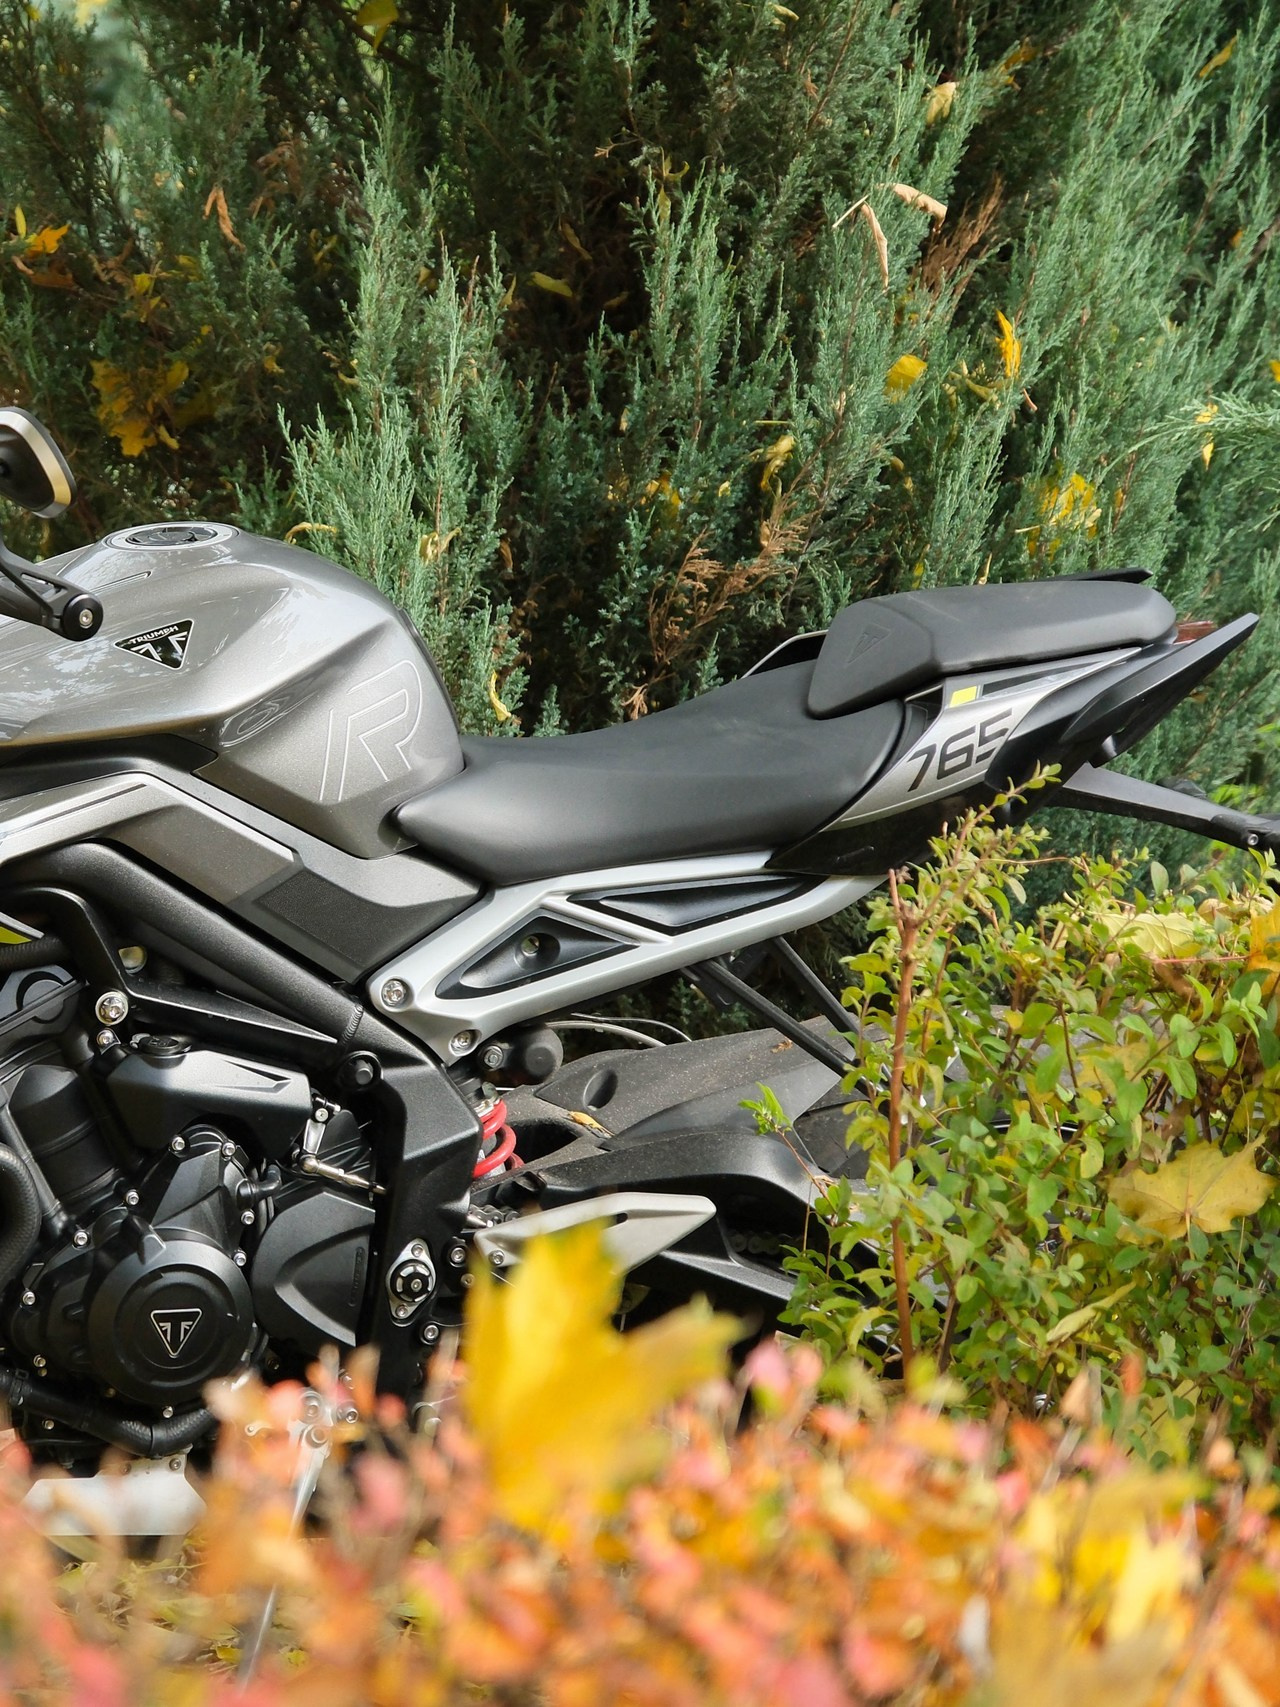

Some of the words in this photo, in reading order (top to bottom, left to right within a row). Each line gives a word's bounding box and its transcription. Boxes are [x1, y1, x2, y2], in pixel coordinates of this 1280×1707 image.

[129, 625, 179, 644] TRIUMPH
[319, 659, 422, 802] R
[907, 708, 1013, 792] 765
